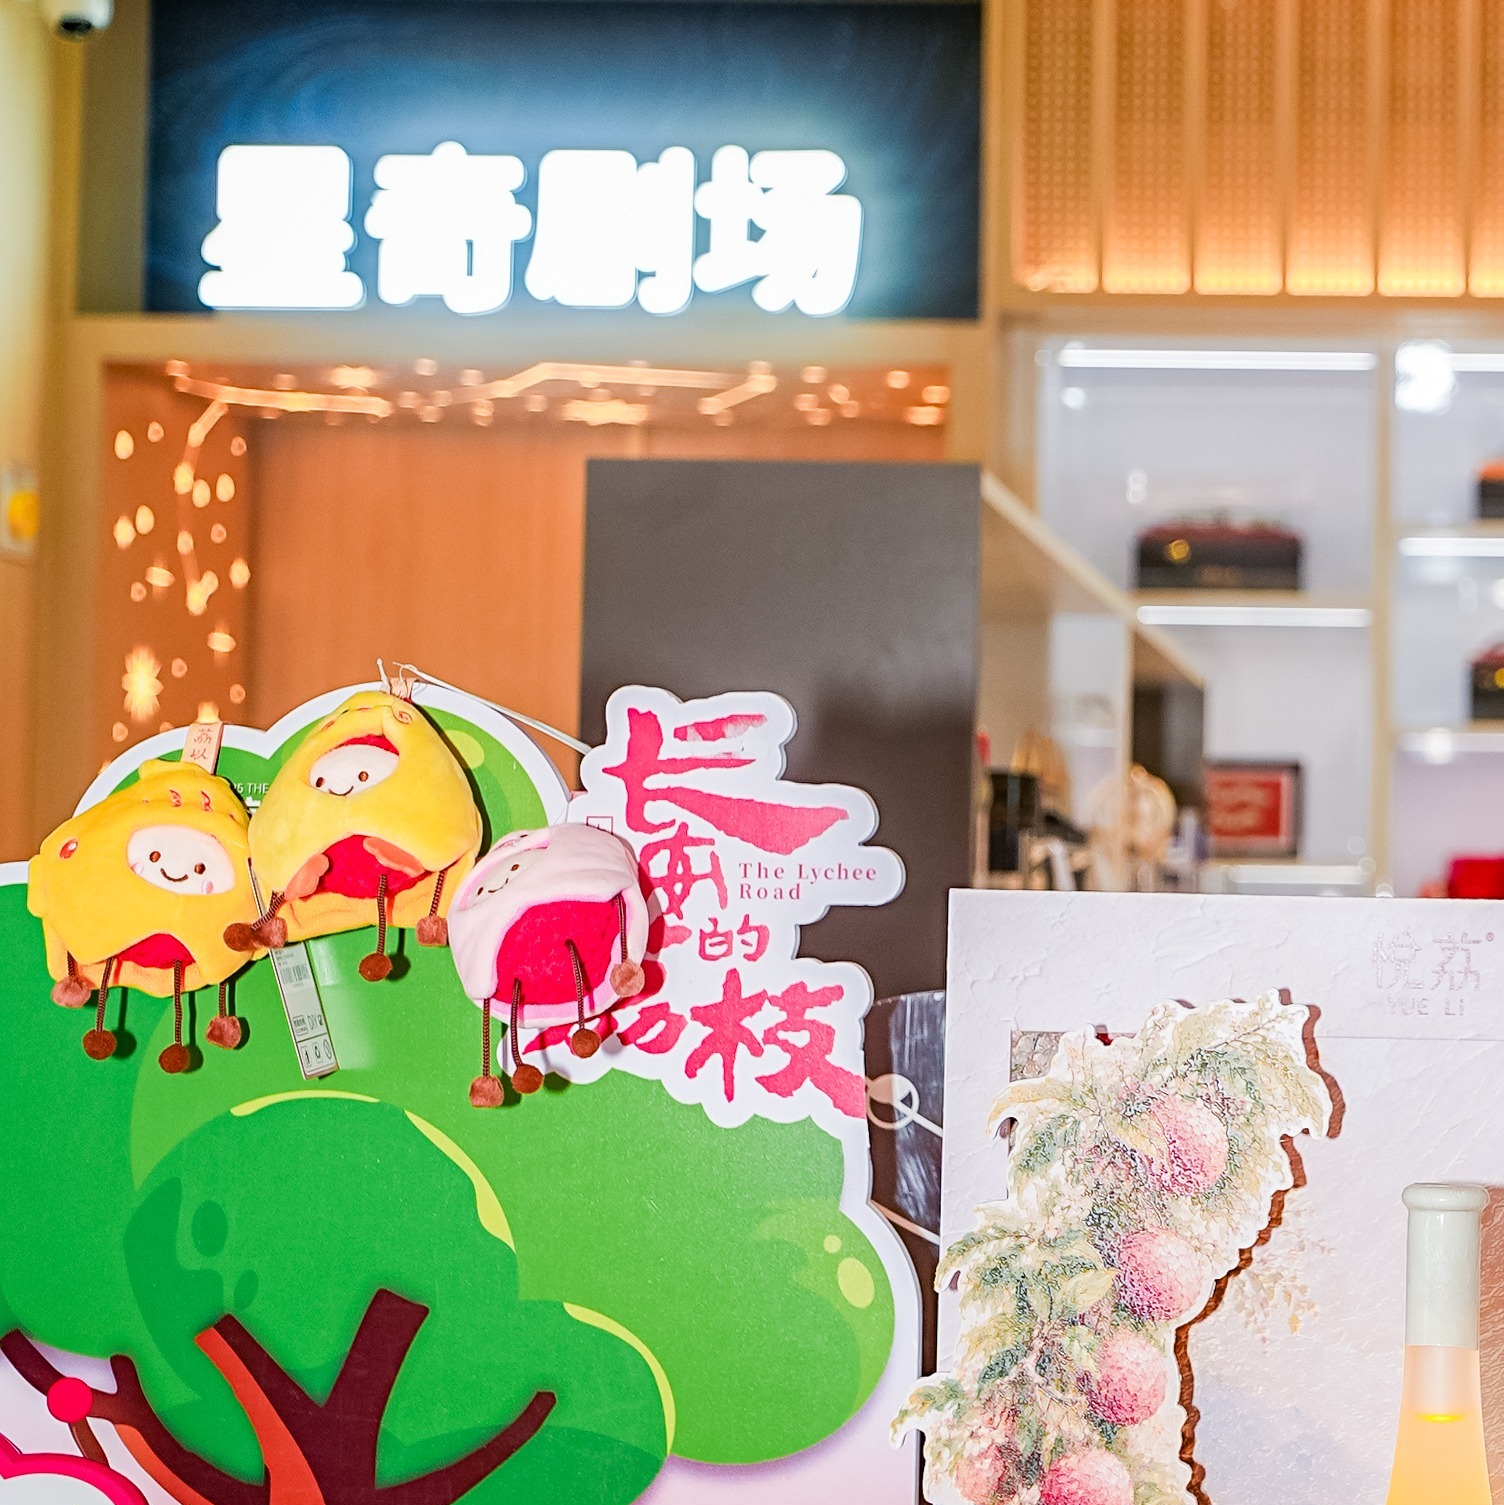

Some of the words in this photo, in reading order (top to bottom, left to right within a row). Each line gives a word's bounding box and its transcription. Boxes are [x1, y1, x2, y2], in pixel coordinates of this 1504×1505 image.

[739, 862, 785, 879] The
[798, 862, 877, 885] Lychee
[739, 883, 801, 900] Road
